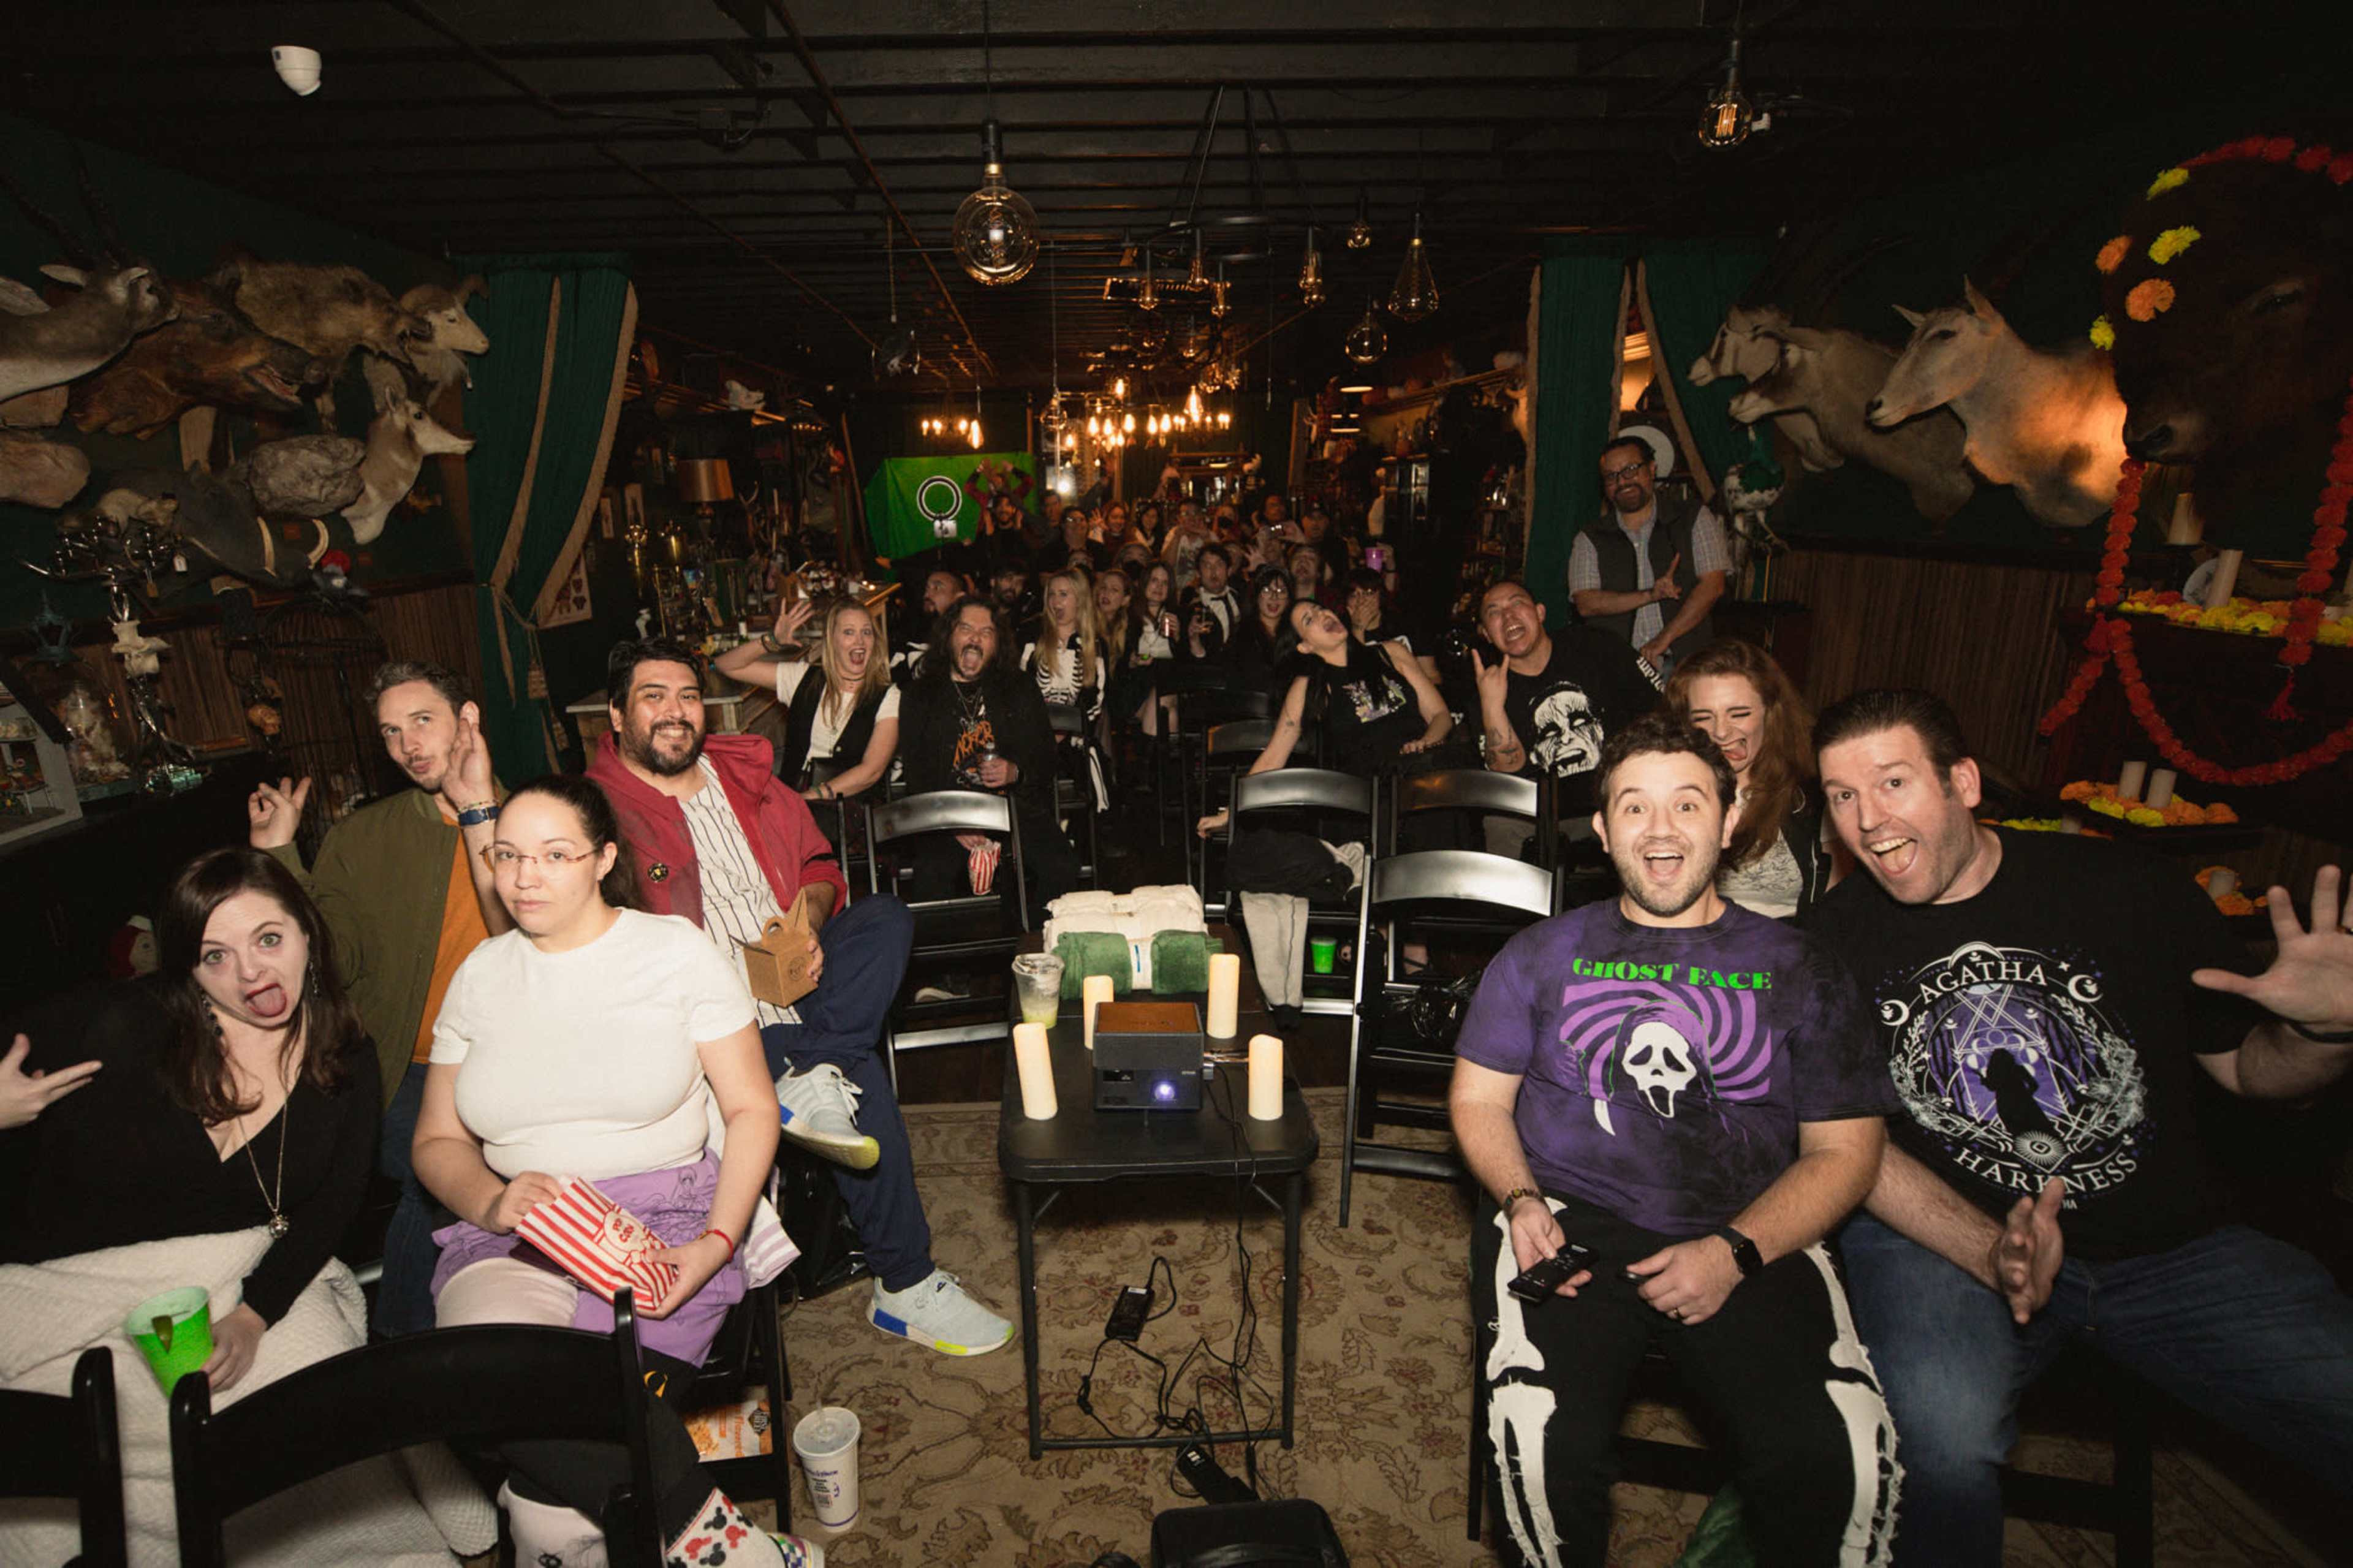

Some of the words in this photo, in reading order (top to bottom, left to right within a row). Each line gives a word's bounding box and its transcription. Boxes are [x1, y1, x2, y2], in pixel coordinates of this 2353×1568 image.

[1572, 958, 1679, 982] GHOST
[1689, 966, 1771, 990] FACE
[1920, 961, 2047, 1004] AGATHA
